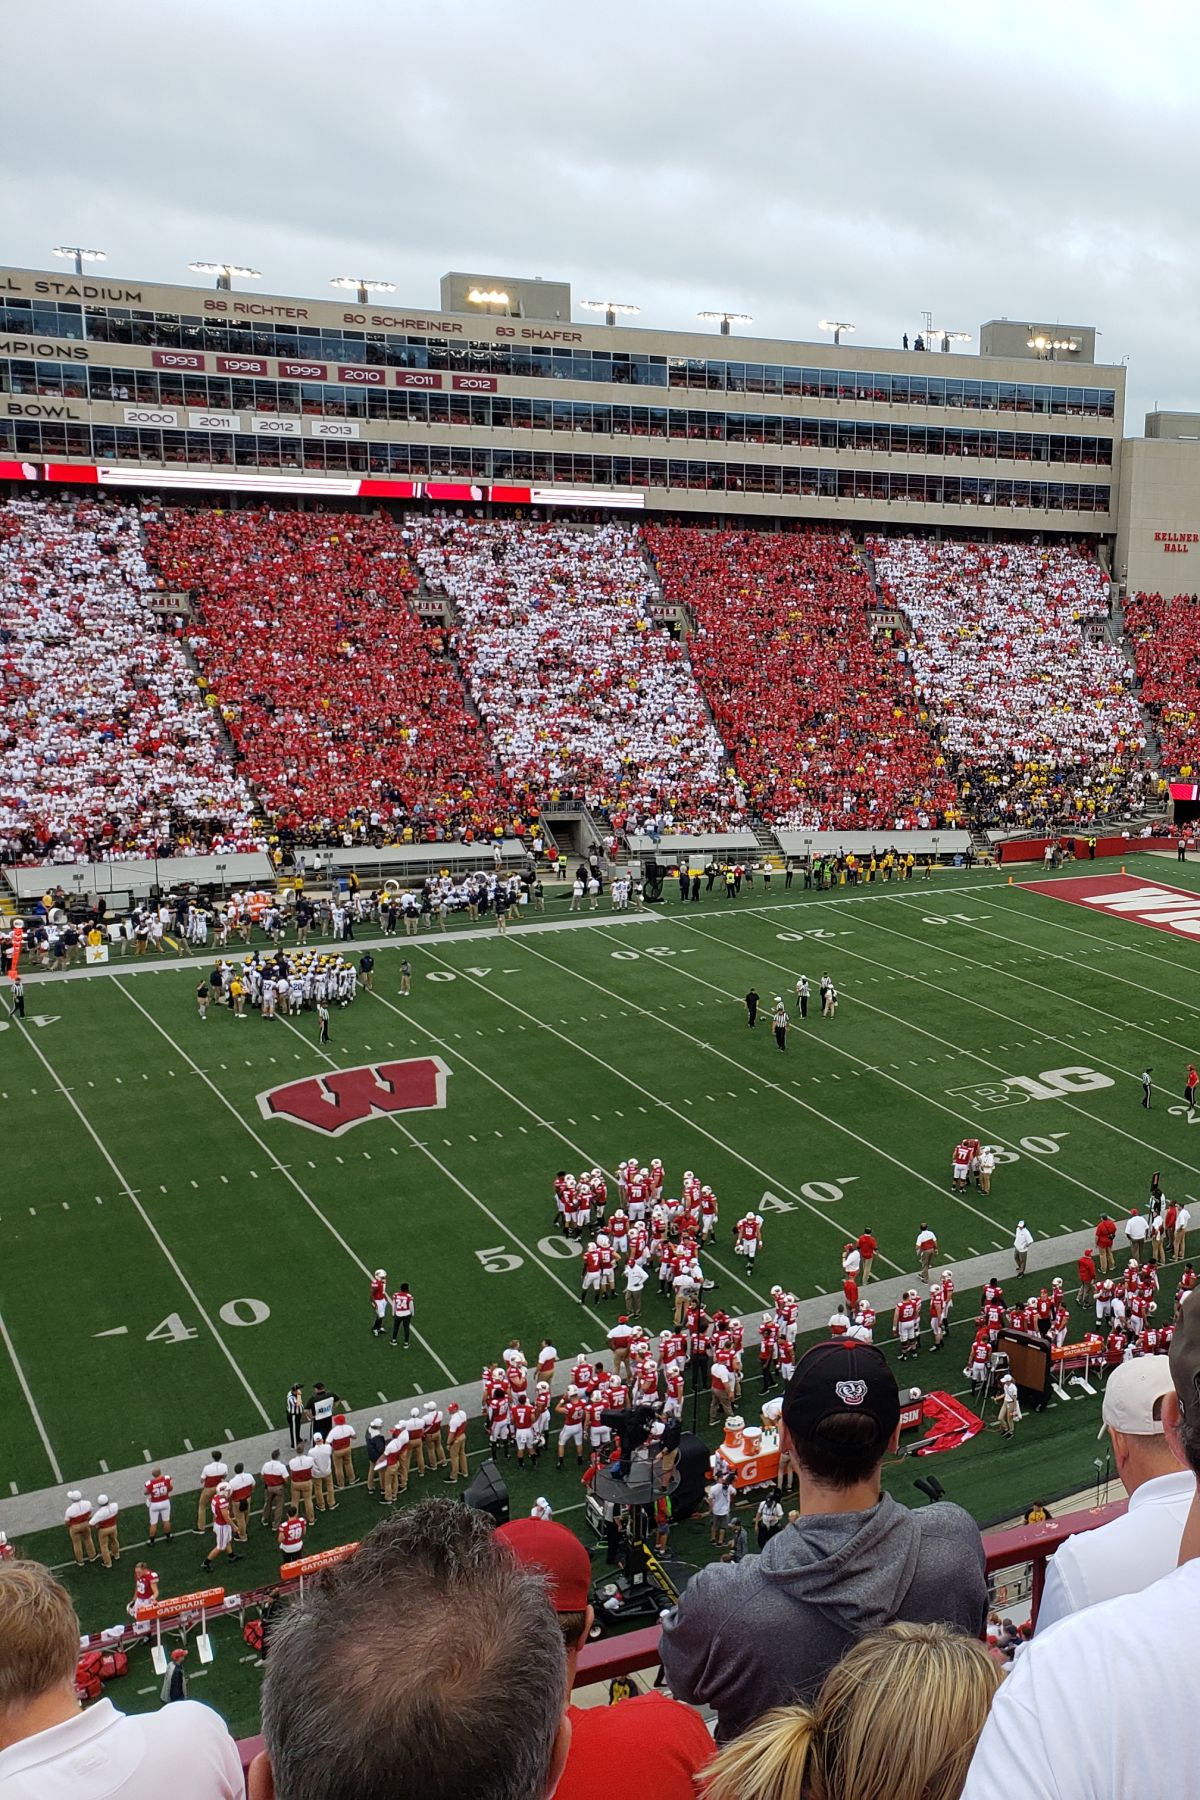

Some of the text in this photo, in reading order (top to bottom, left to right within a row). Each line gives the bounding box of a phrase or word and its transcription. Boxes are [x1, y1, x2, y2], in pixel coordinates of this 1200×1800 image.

[35, 280, 142, 303] STADIUM
[204, 299, 309, 320] 88 RICHTER
[343, 313, 463, 334] 80 SCHREINER
[496, 326, 583, 343] 83 SHAFER
[159, 354, 199, 367] 1993
[223, 360, 261, 373] 1998
[285, 365, 322, 378] 1999
[344, 370, 380, 382] 2010
[404, 374, 434, 386] 2011
[459, 379, 491, 391] 2012
[8, 402, 80, 420] BOWL
[127, 412, 174, 424] 2000
[199, 416, 231, 428] 2011
[259, 420, 294, 433] 2012
[319, 424, 353, 436] 2013
[1154, 532, 1199, 543] KELLNER
[1164, 543, 1189, 553] HALL
[757, 1180, 846, 1214] 40
[474, 1234, 583, 1274] 50
[394, 1299, 406, 1308] 24
[145, 1298, 271, 1344] 40
[1063, 1346, 1092, 1356] GATORADE
[518, 1412, 525, 1424] 7
[899, 1409, 921, 1425] SIN
[741, 1461, 759, 1481] G
[156, 1598, 206, 1616] GATORADE
